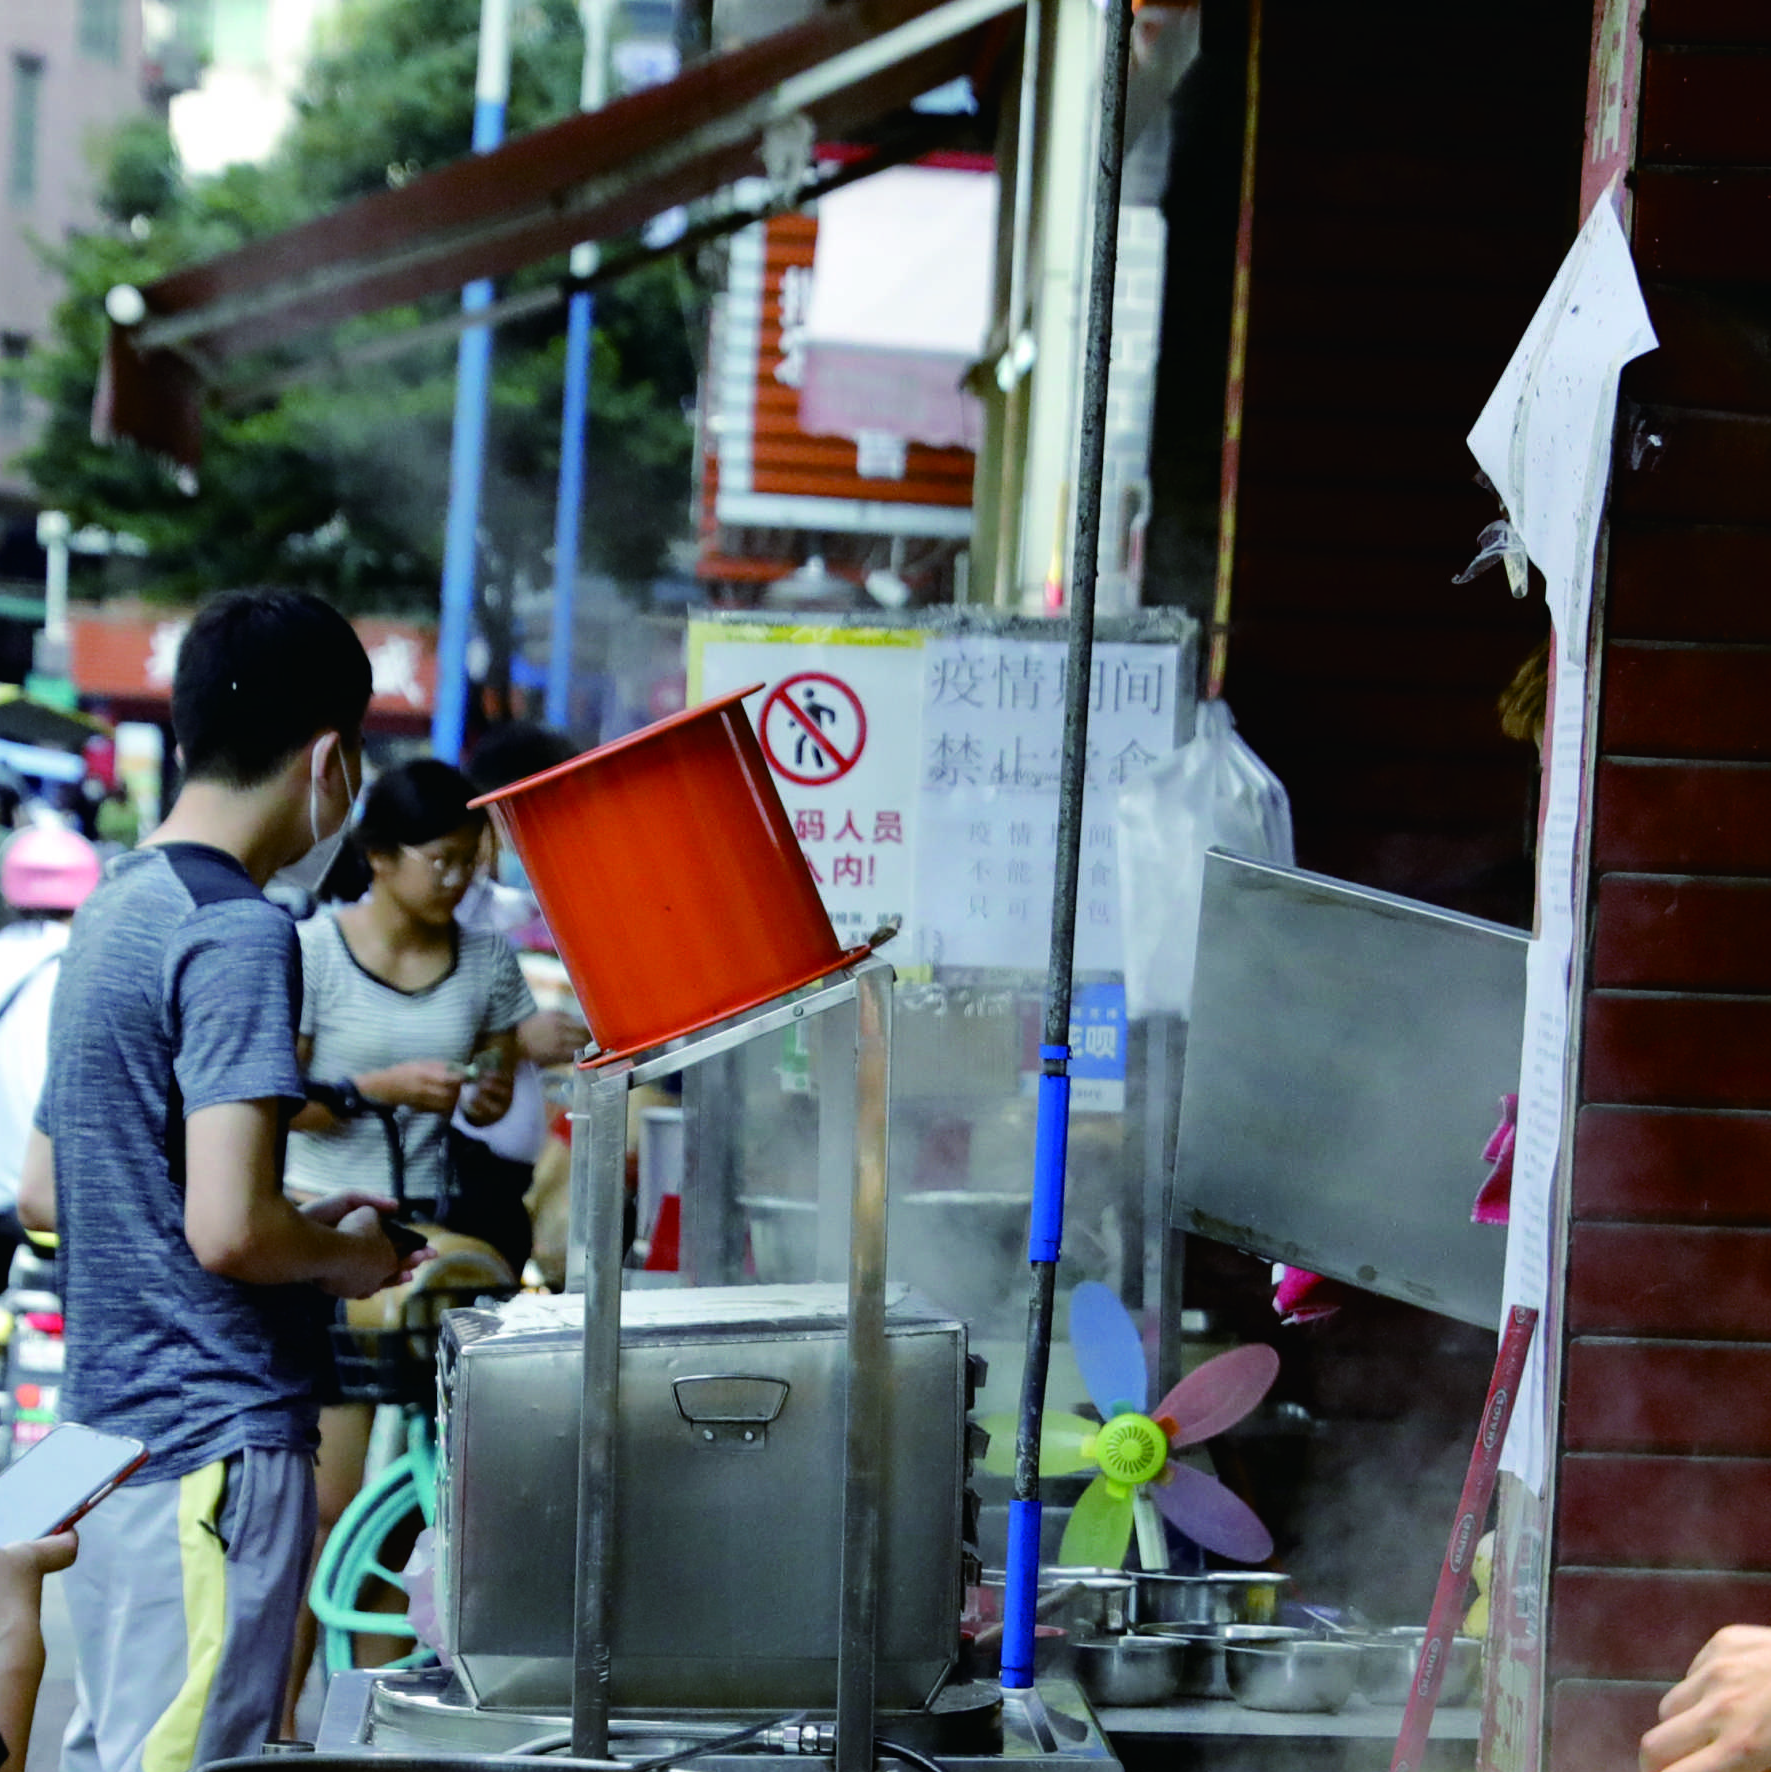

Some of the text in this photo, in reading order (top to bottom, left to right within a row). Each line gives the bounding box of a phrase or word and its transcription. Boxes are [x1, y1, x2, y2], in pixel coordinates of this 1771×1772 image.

[794, 809, 903, 844] 码人员
[968, 821, 1112, 849] 疫情间
[970, 857, 1112, 889] 不能食
[967, 894, 1110, 925] 只可包
